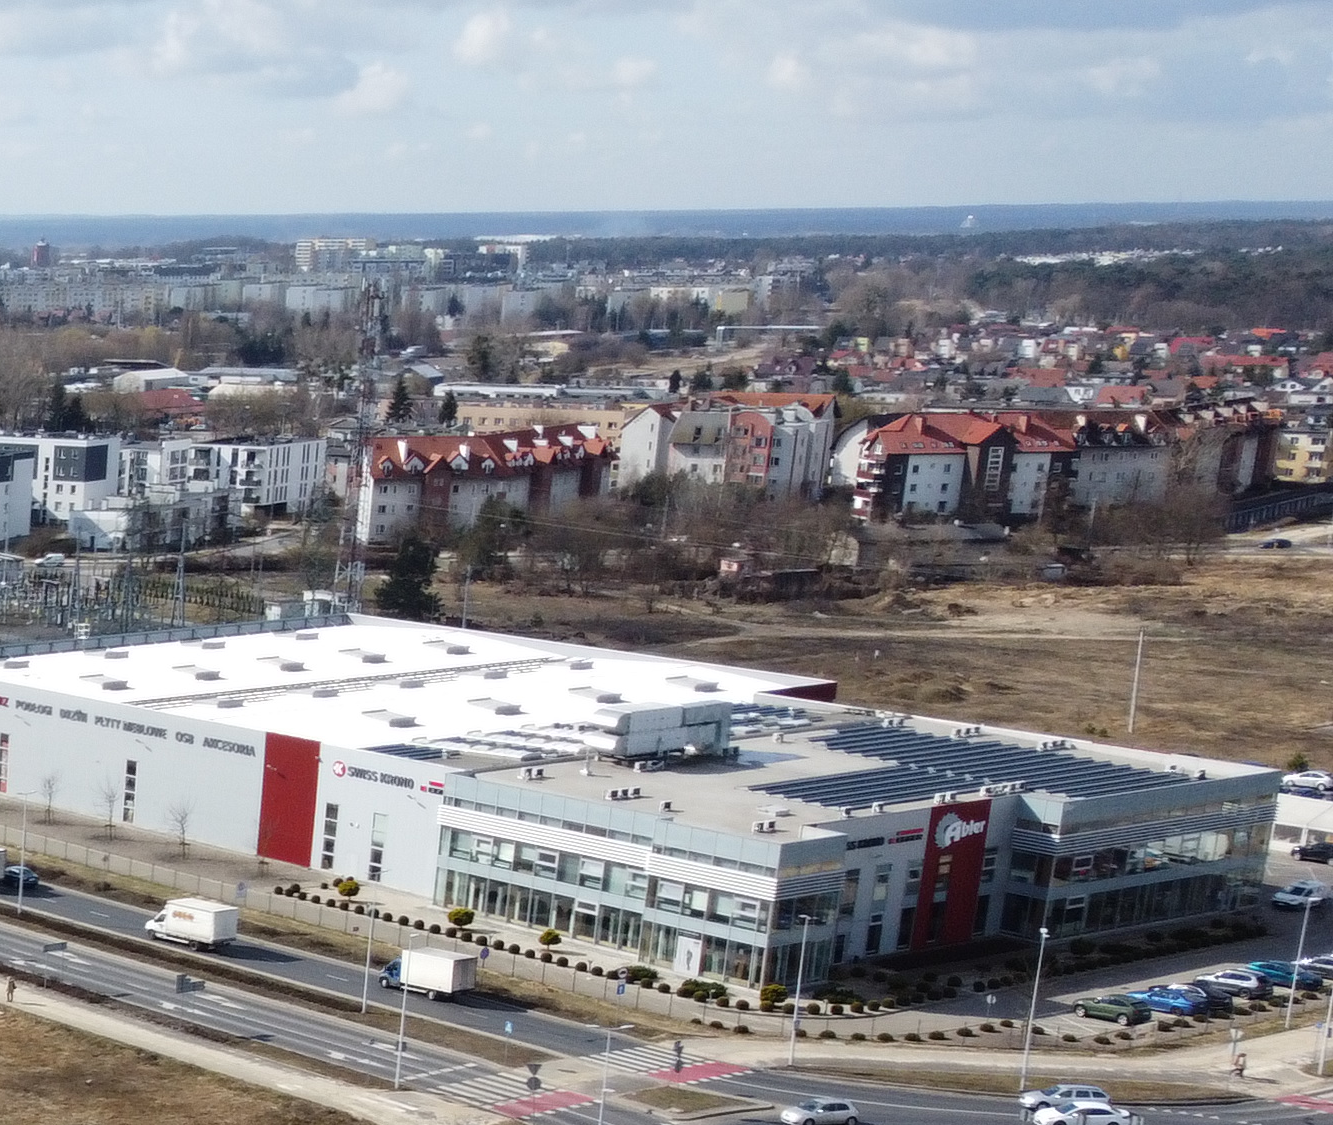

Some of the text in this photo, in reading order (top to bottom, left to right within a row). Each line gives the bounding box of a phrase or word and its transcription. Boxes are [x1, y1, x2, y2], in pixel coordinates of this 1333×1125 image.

[15, 700, 53, 716] PODŁOGI
[59, 708, 88, 724] DRZWI
[94, 716, 122, 731] PŁYTY
[122, 720, 168, 740] MEBLOWE
[175, 731, 195, 745] OSB
[202, 736, 257, 758] AKCESORIA
[347, 766, 378, 782] SWISS
[380, 772, 415, 789] KRONO
[944, 819, 986, 848] Abler
